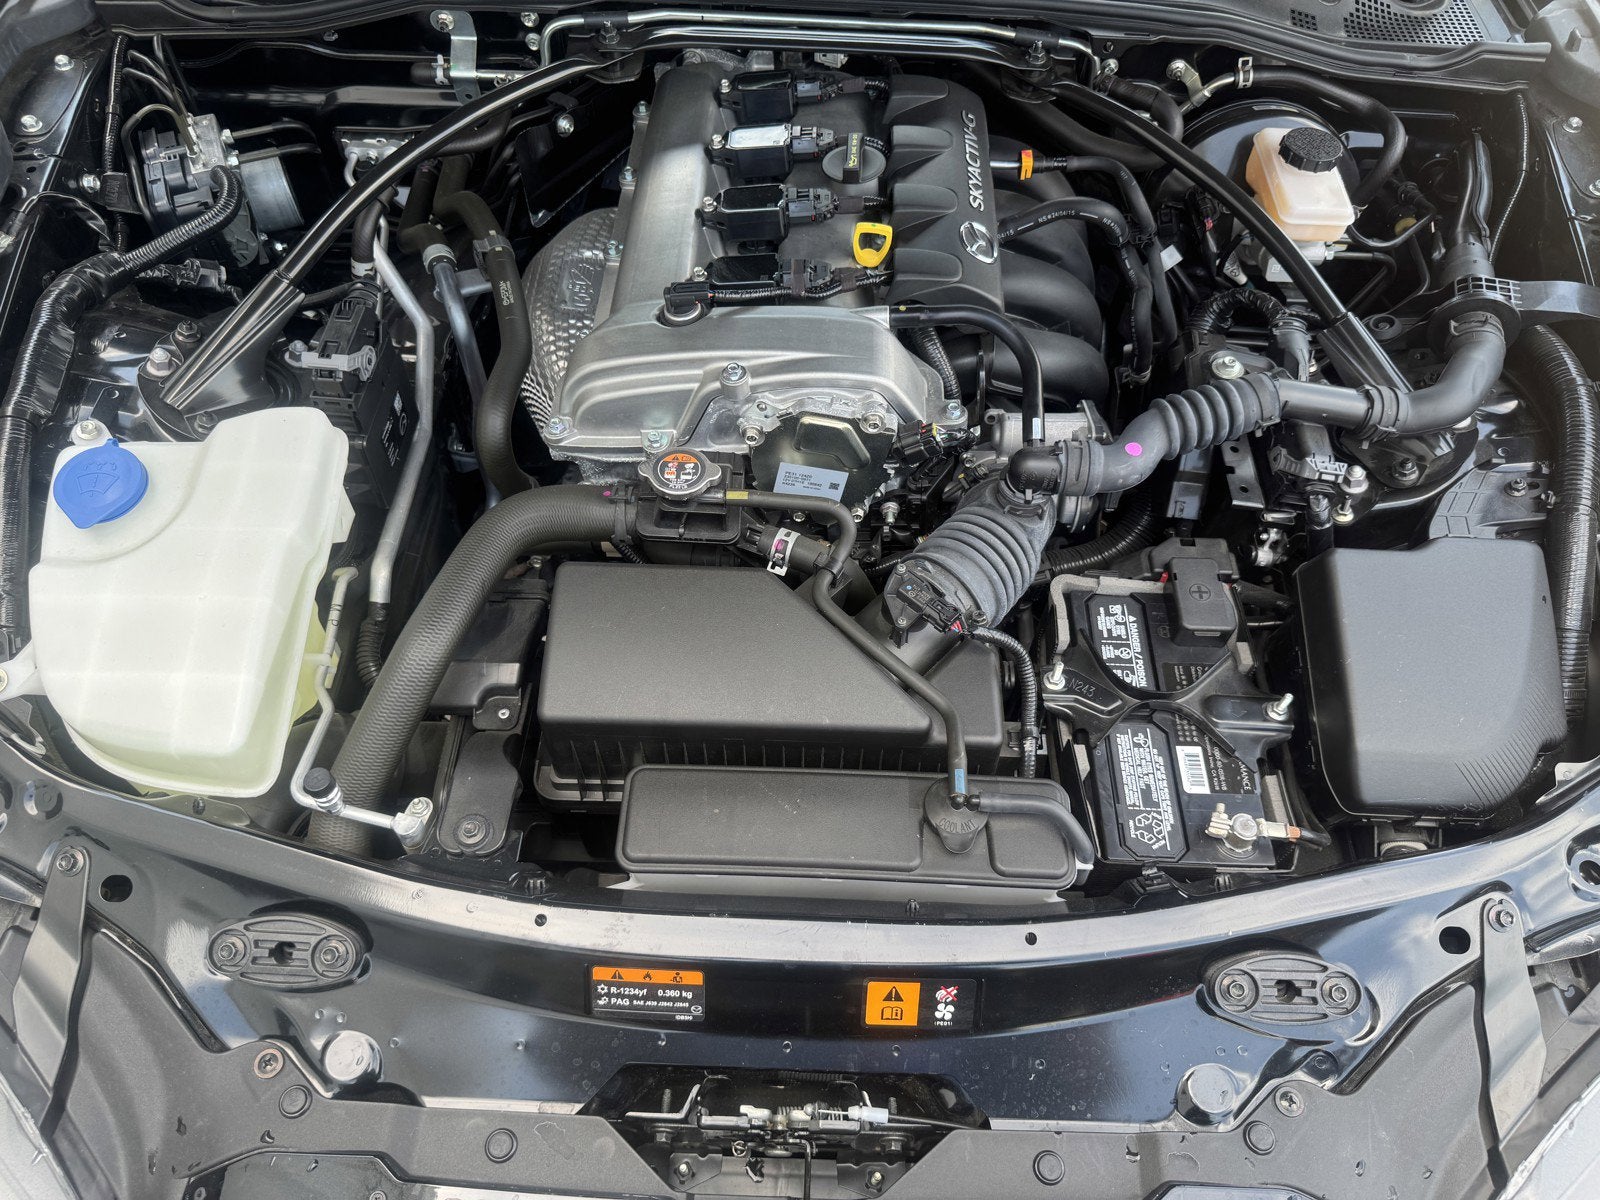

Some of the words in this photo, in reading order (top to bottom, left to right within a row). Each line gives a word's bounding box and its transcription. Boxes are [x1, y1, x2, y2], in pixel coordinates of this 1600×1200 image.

[960, 110, 985, 212] SKYACTIV-G
[1130, 622, 1140, 653] DANGER
[1136, 659, 1147, 687] POISON
[1239, 761, 1251, 790] MANCE
[939, 818, 975, 832] COOLANT
[610, 987, 647, 996] R-1234yf
[682, 990, 692, 998] kg
